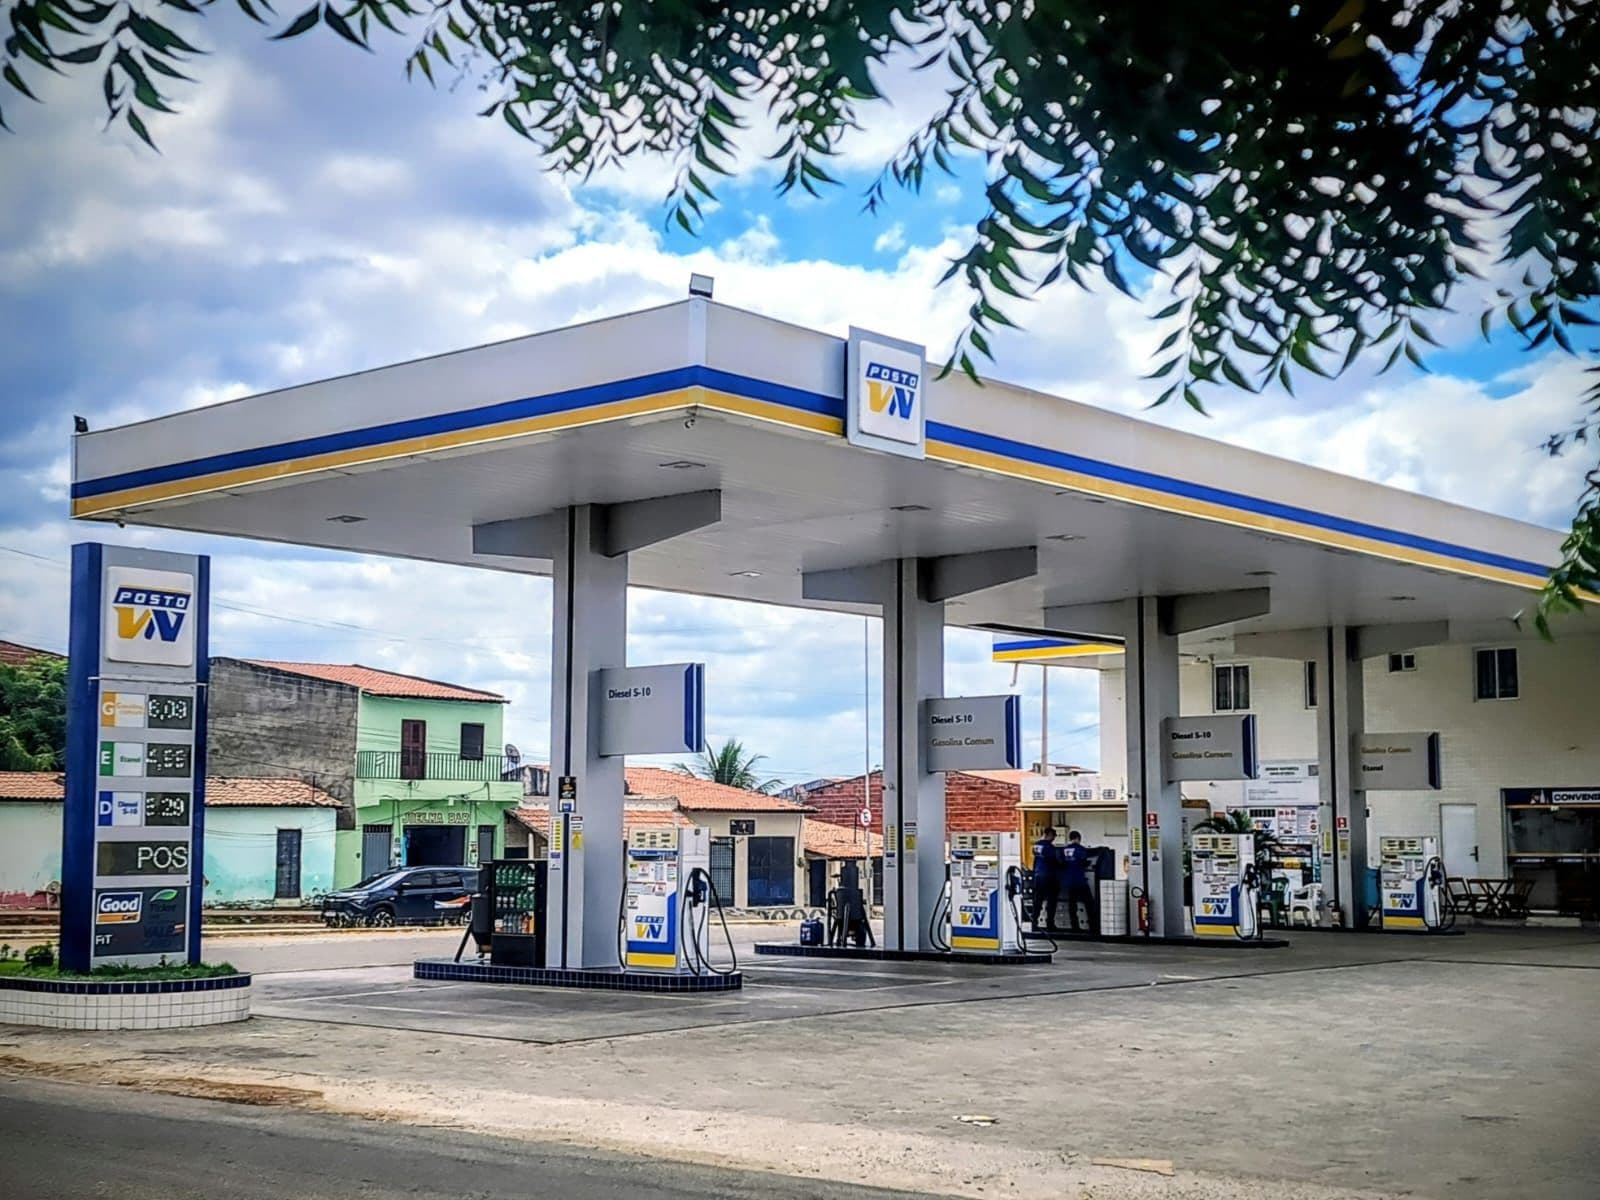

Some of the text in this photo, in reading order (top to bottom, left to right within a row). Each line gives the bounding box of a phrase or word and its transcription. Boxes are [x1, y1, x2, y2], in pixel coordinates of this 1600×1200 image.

[869, 365, 917, 387] POSTO
[117, 590, 187, 609] POSTO
[608, 687, 651, 699] Diesel S-10
[102, 702, 114, 716] G
[931, 714, 973, 724] Diesel S-10
[1171, 731, 1212, 740] Diesel S-10
[101, 750, 111, 765] E
[99, 800, 112, 816] D
[447, 812, 471, 824] BAR
[137, 846, 188, 869] POS
[100, 897, 140, 912] Good
